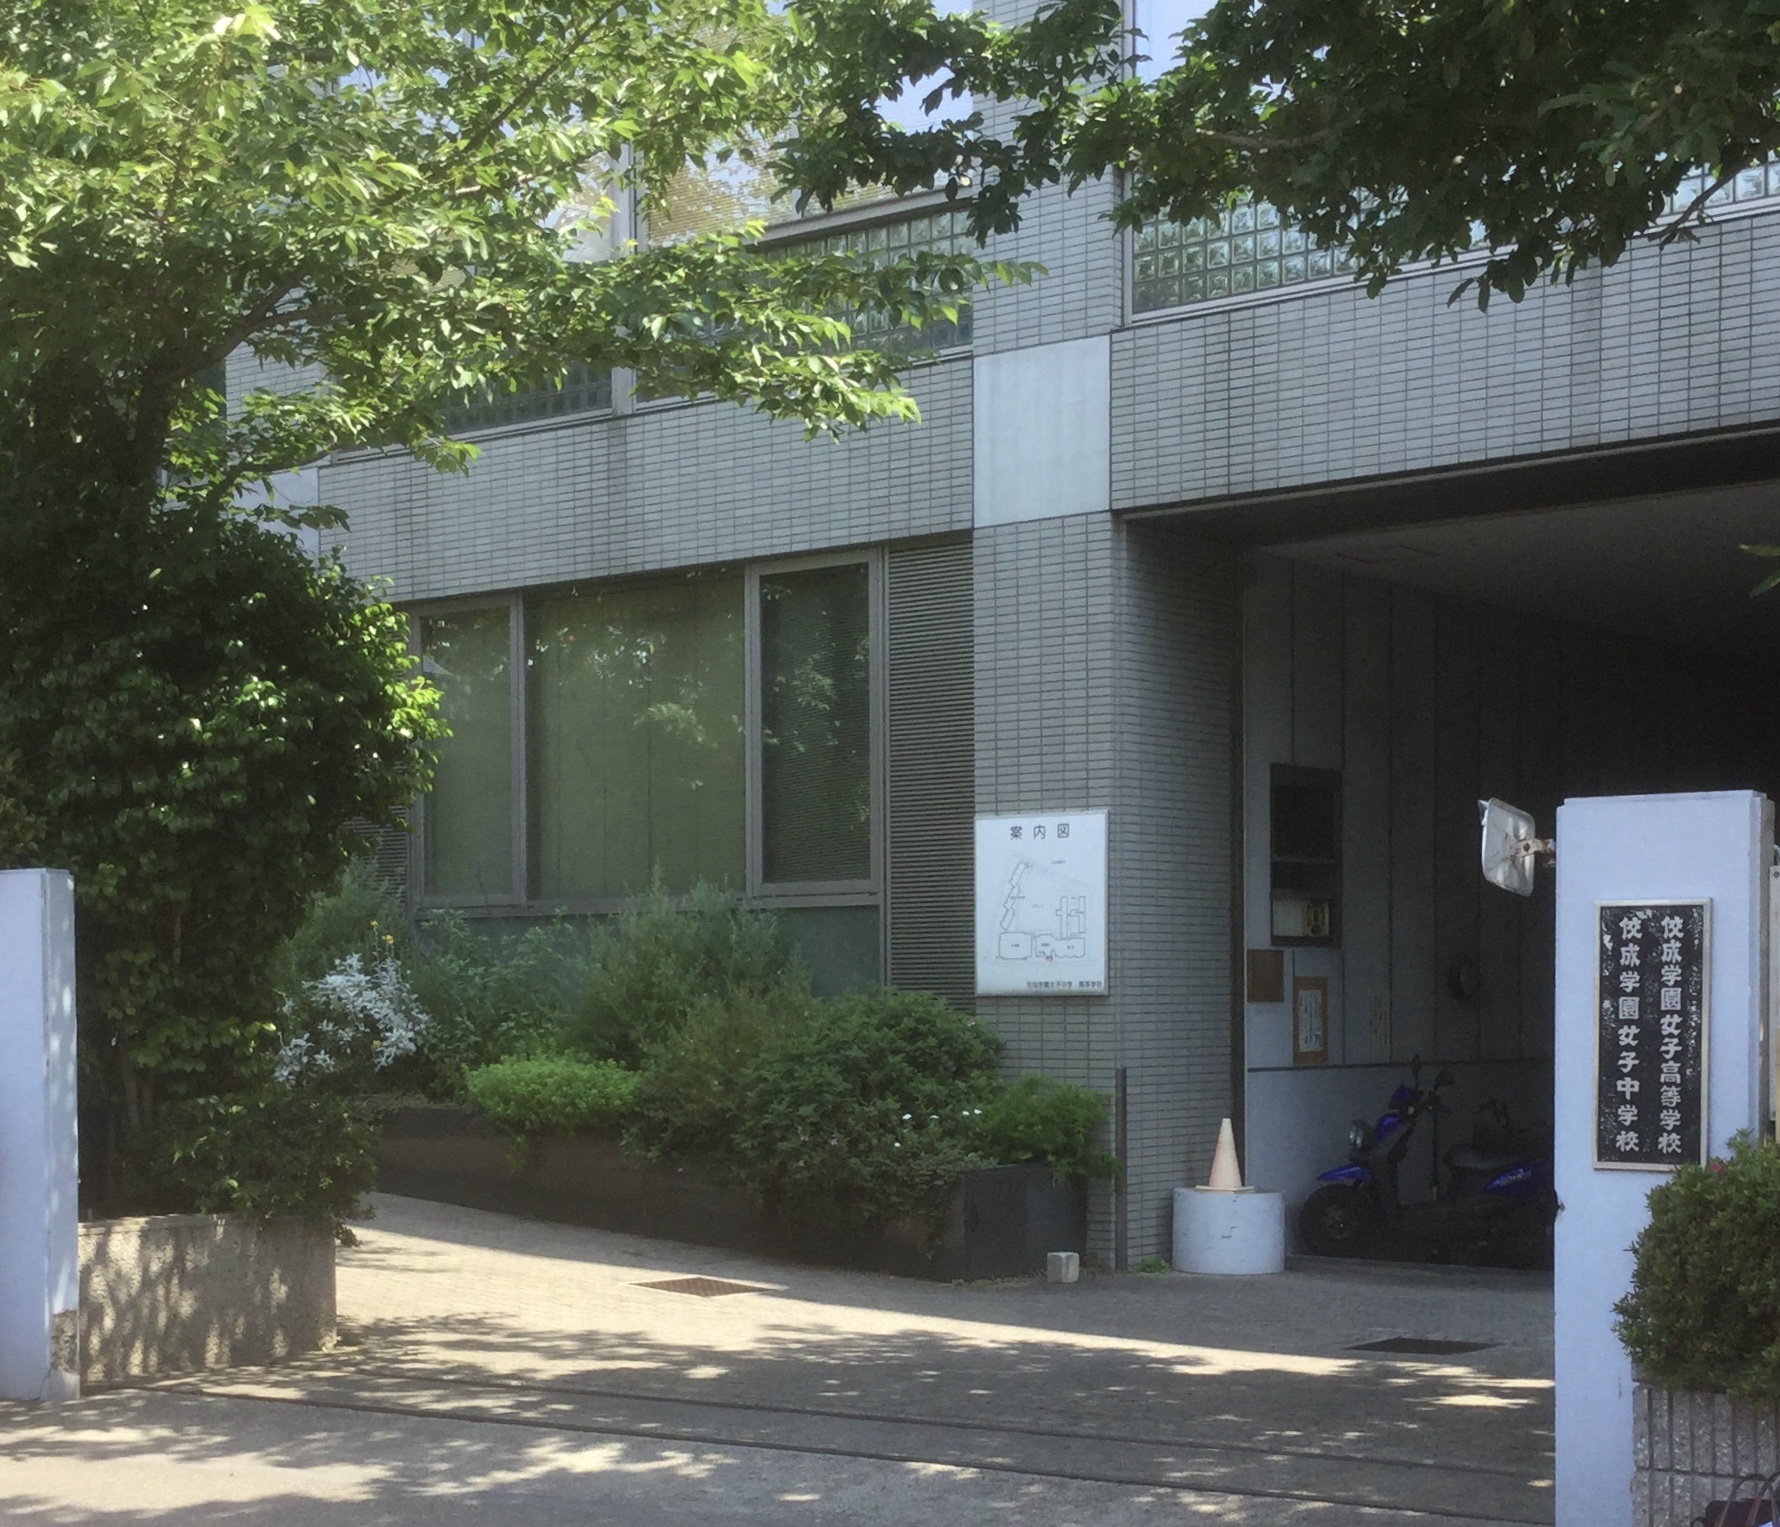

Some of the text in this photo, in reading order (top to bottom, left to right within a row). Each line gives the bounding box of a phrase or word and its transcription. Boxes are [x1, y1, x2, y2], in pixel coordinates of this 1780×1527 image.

[1010, 824, 1069, 840] 案内図
[1616, 916, 1643, 1153] 佼成学園女子中学校
[1658, 916, 1684, 1154] 佼成学園女子高等学校
